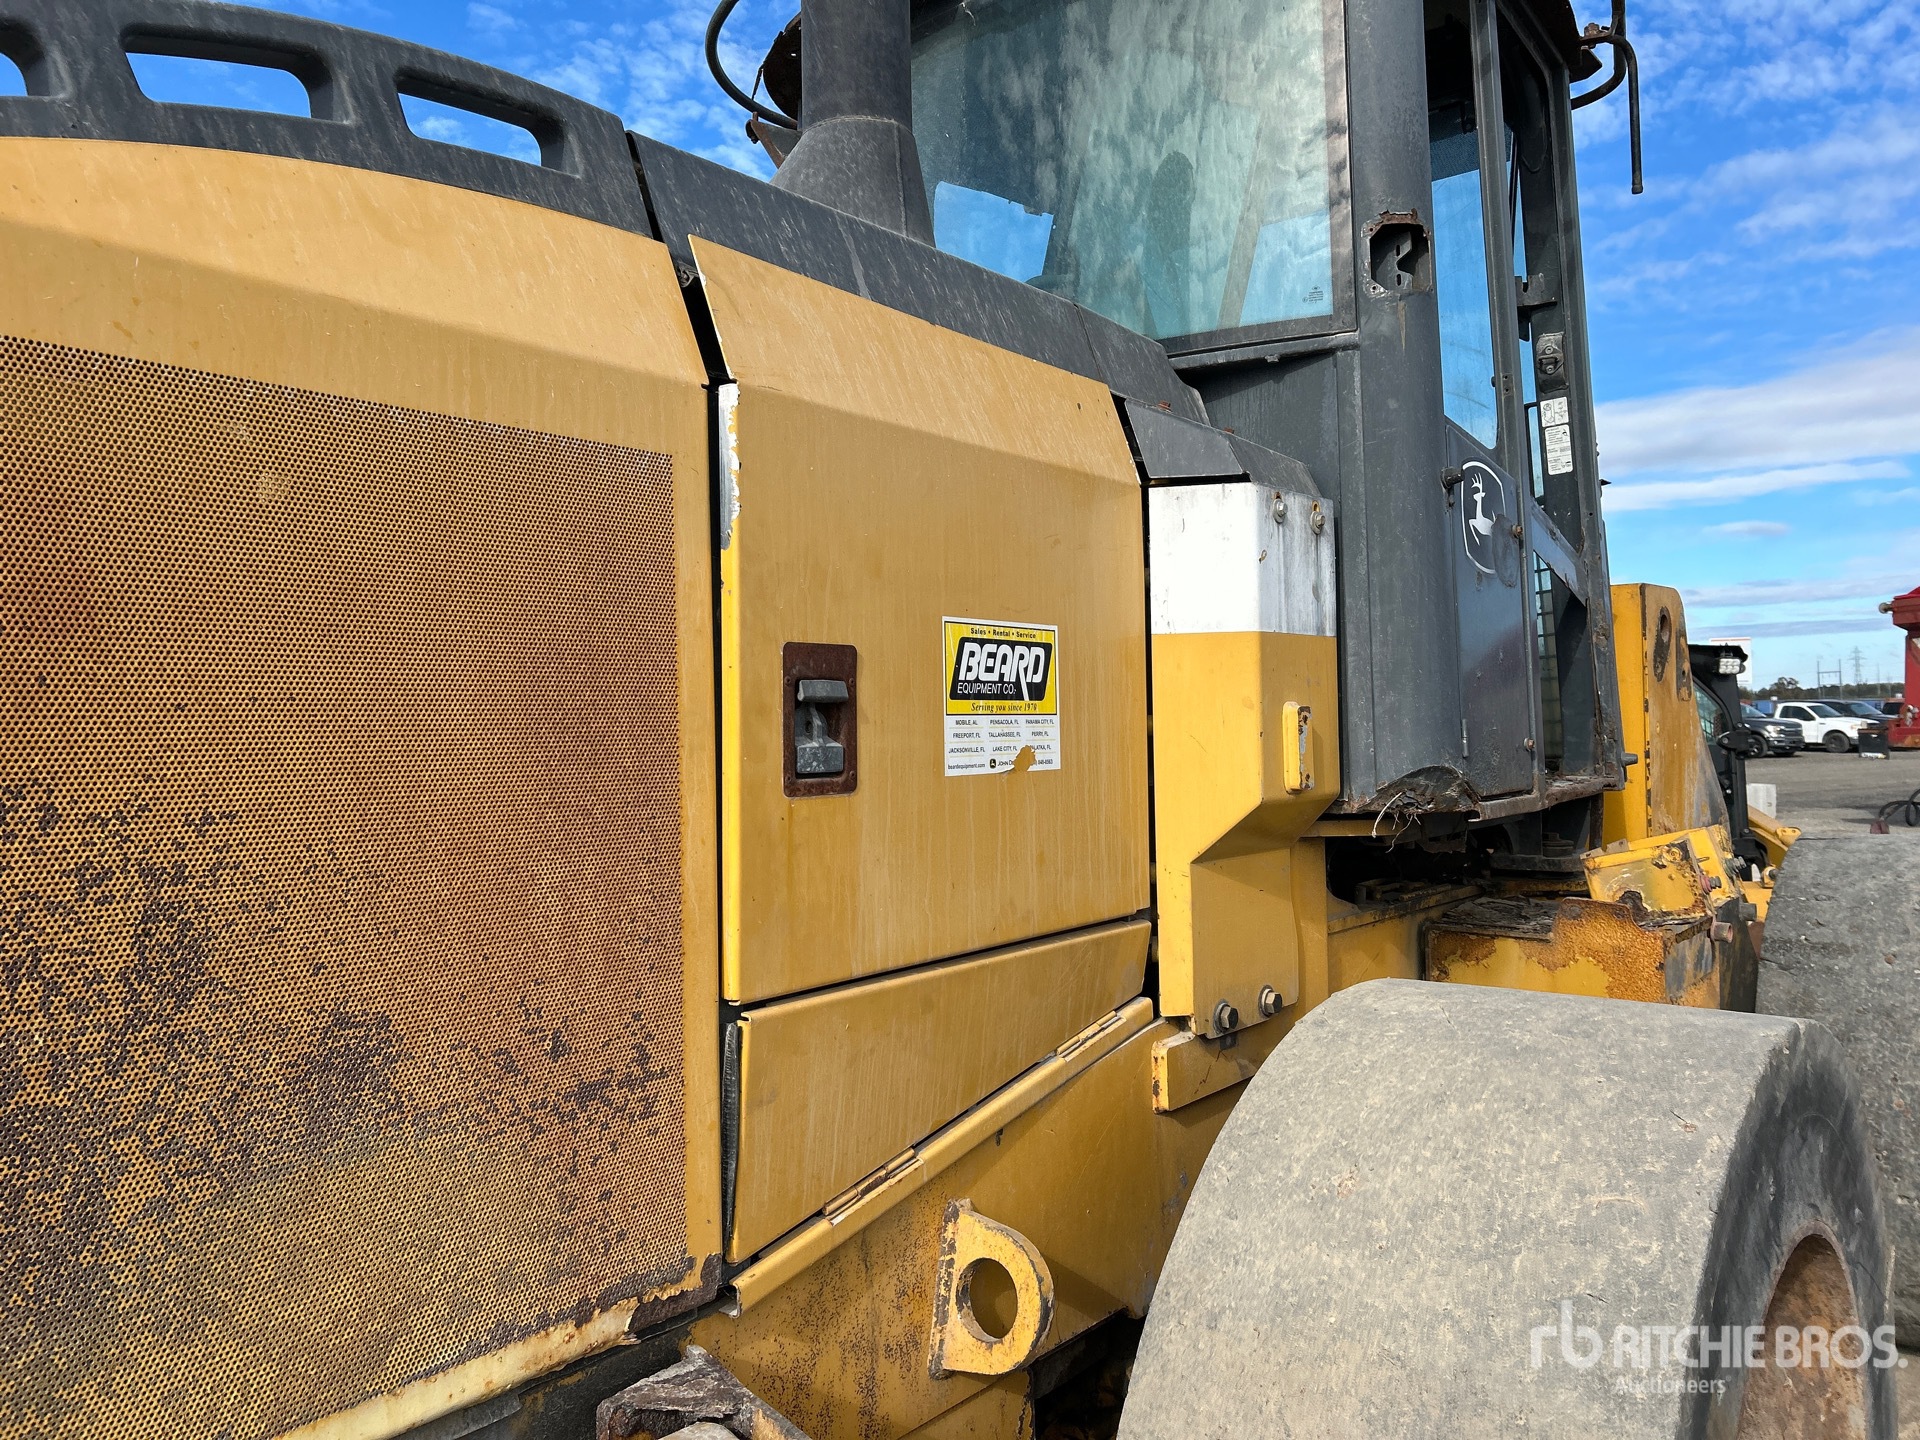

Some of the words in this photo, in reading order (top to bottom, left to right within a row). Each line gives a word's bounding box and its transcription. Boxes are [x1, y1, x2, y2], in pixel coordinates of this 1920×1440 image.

[992, 629, 1011, 637] Rental
[1016, 631, 1036, 639] Service
[959, 642, 1045, 701] BEARD
[957, 682, 1001, 694] EQUIPMENT
[971, 702, 994, 713] Serving
[996, 704, 1007, 714] you
[1008, 703, 1022, 711] since
